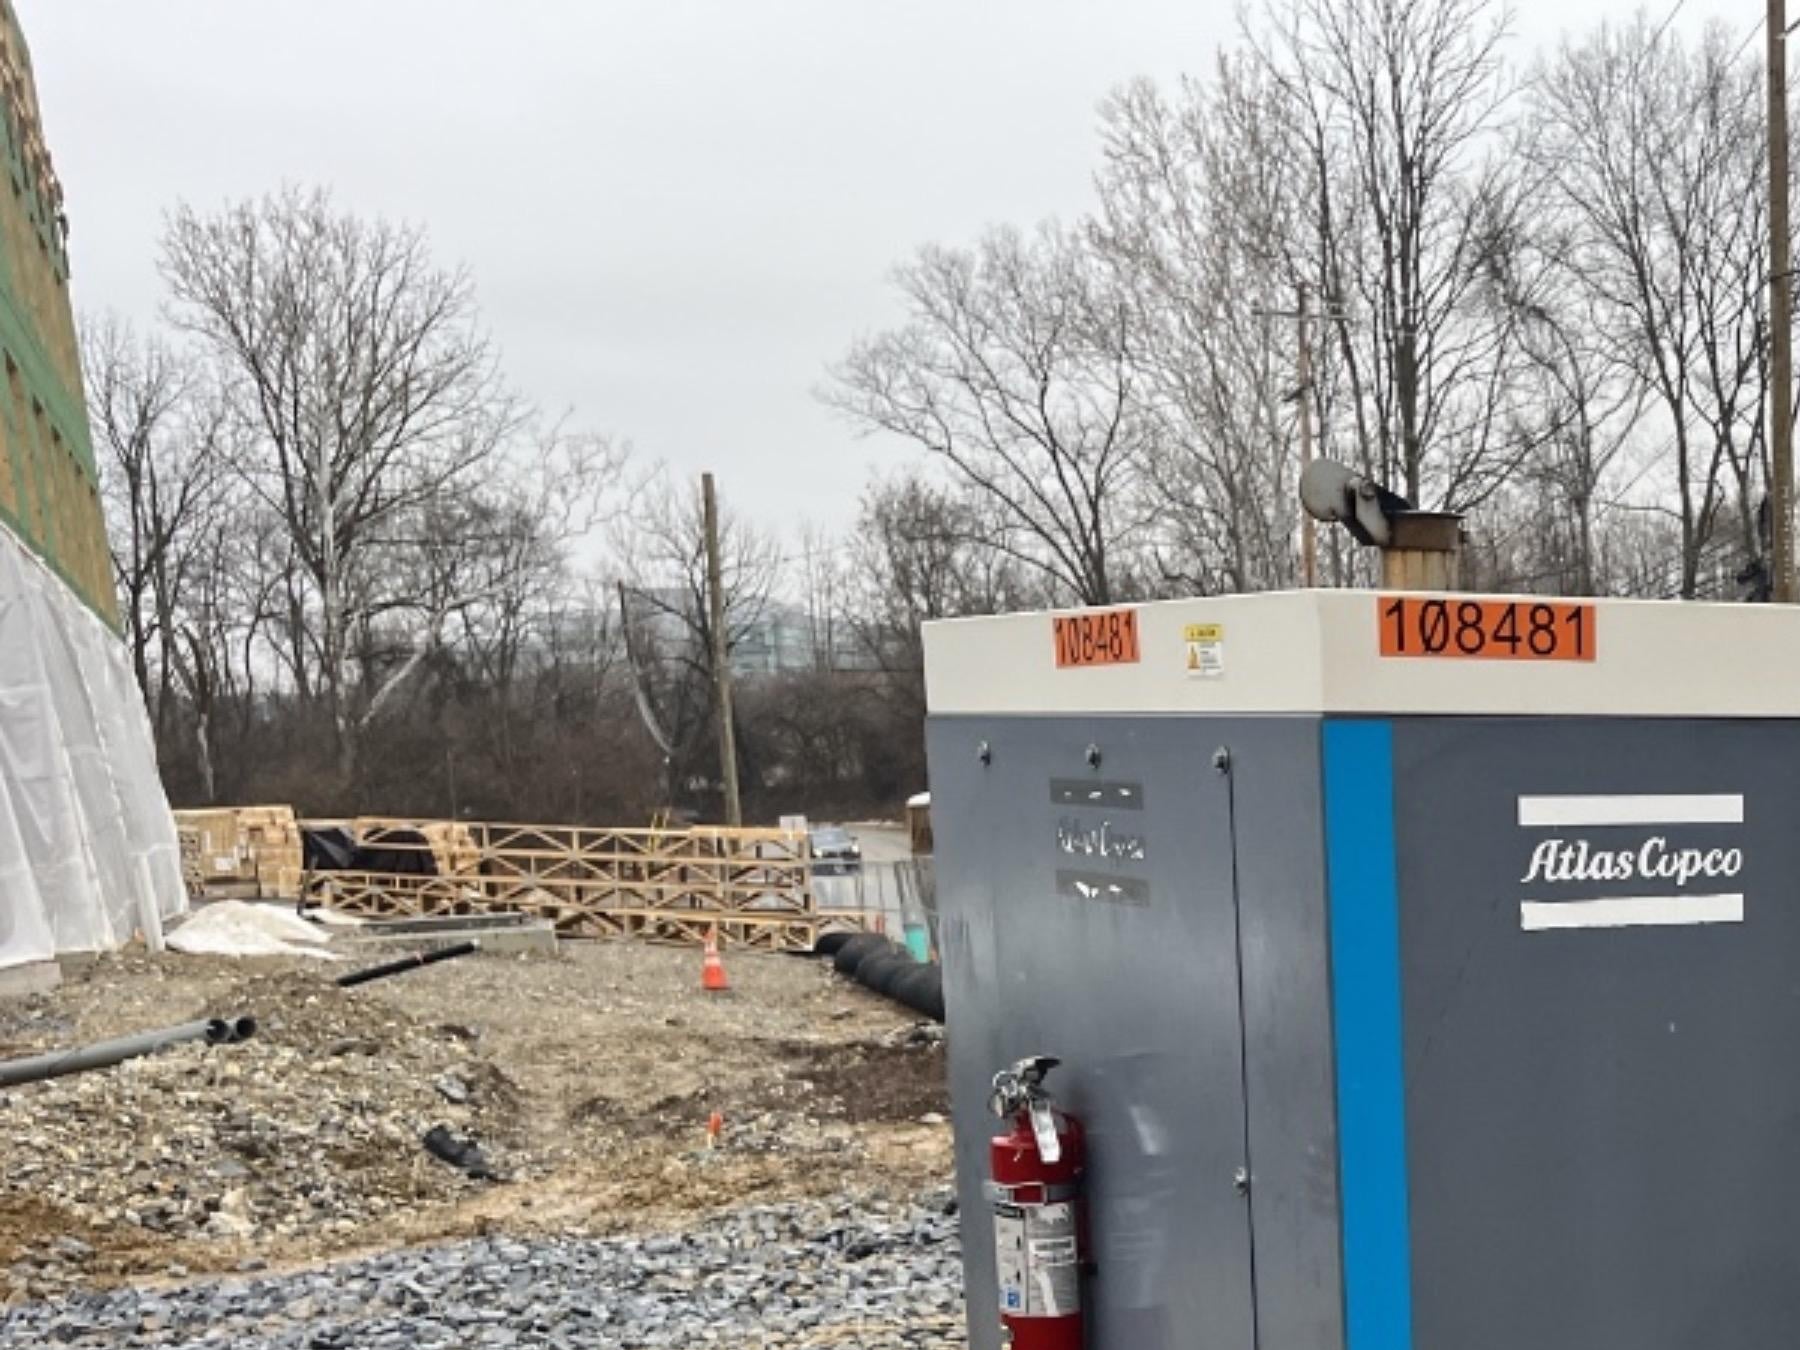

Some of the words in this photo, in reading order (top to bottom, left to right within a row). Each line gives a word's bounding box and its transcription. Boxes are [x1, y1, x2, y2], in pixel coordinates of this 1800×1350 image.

[1053, 609, 1138, 665] 108481
[1384, 597, 1583, 656] 108481
[1519, 838, 1635, 884] Atlas
[1637, 835, 1743, 886] Copco
